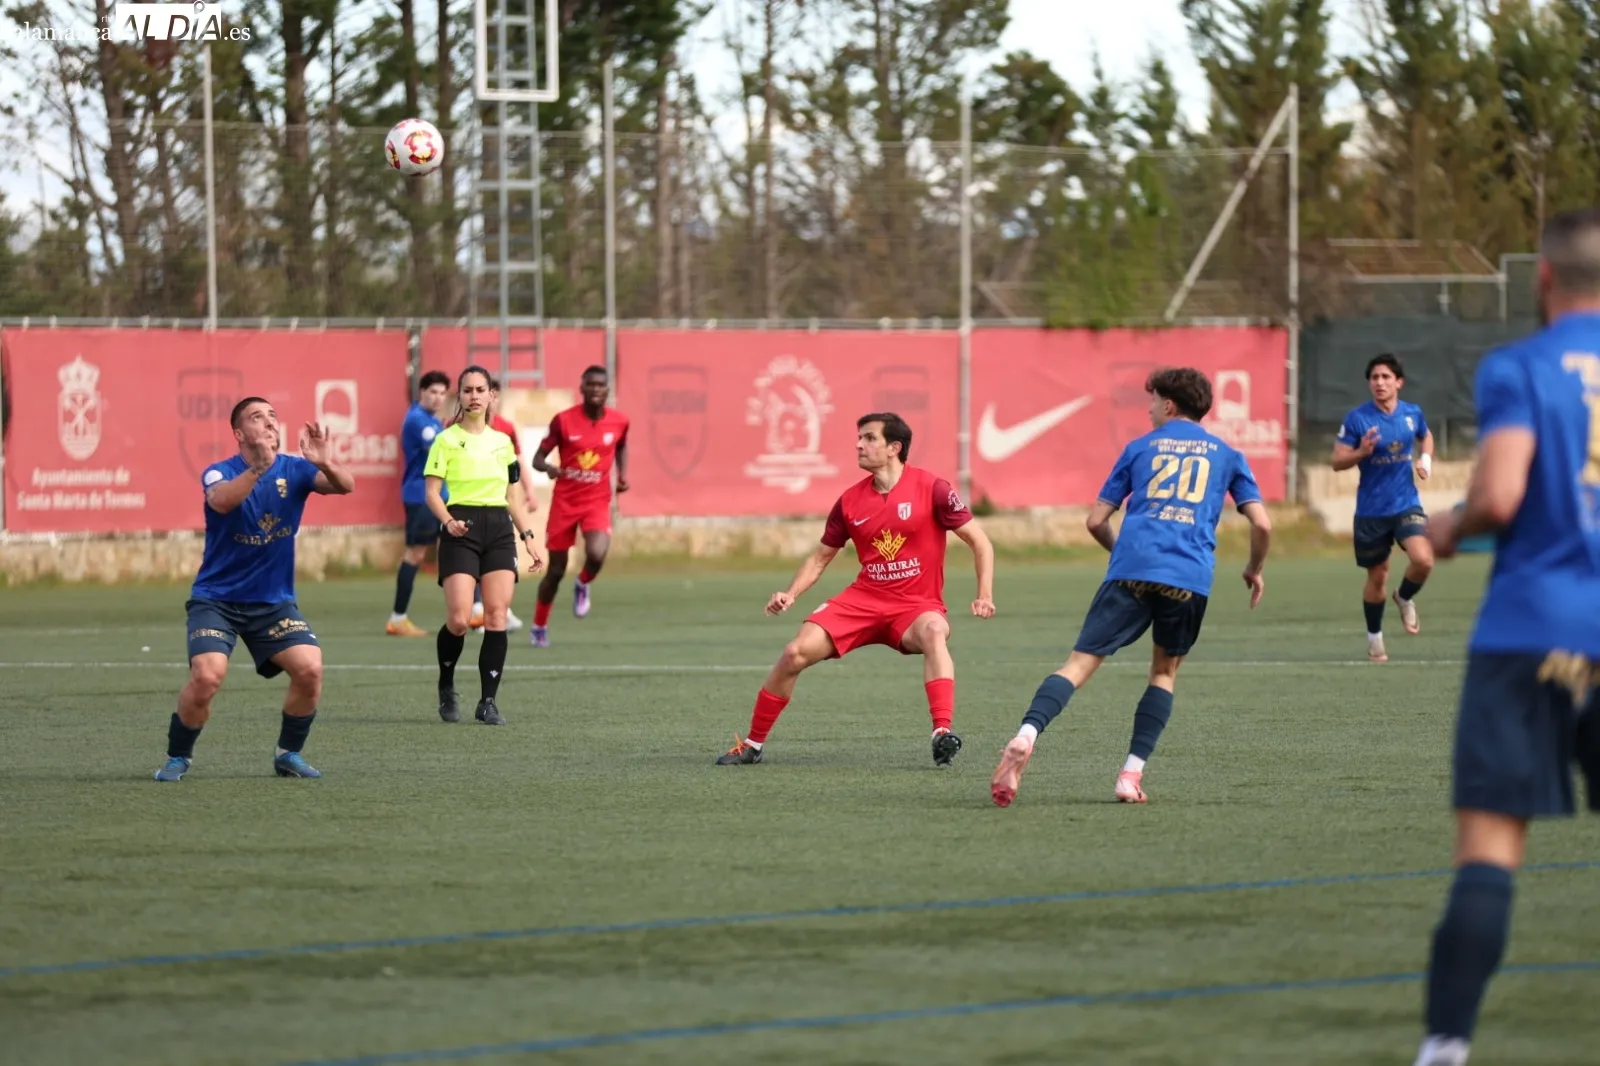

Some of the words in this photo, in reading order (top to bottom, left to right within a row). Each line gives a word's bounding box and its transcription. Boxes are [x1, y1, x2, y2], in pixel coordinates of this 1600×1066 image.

[1147, 454, 1211, 504] 20
[17, 490, 51, 511] Santa
[53, 489, 87, 510] Marta
[867, 563, 886, 574] CAJA
[887, 557, 921, 572] RURAL
[876, 567, 921, 581] SALAMANCA
